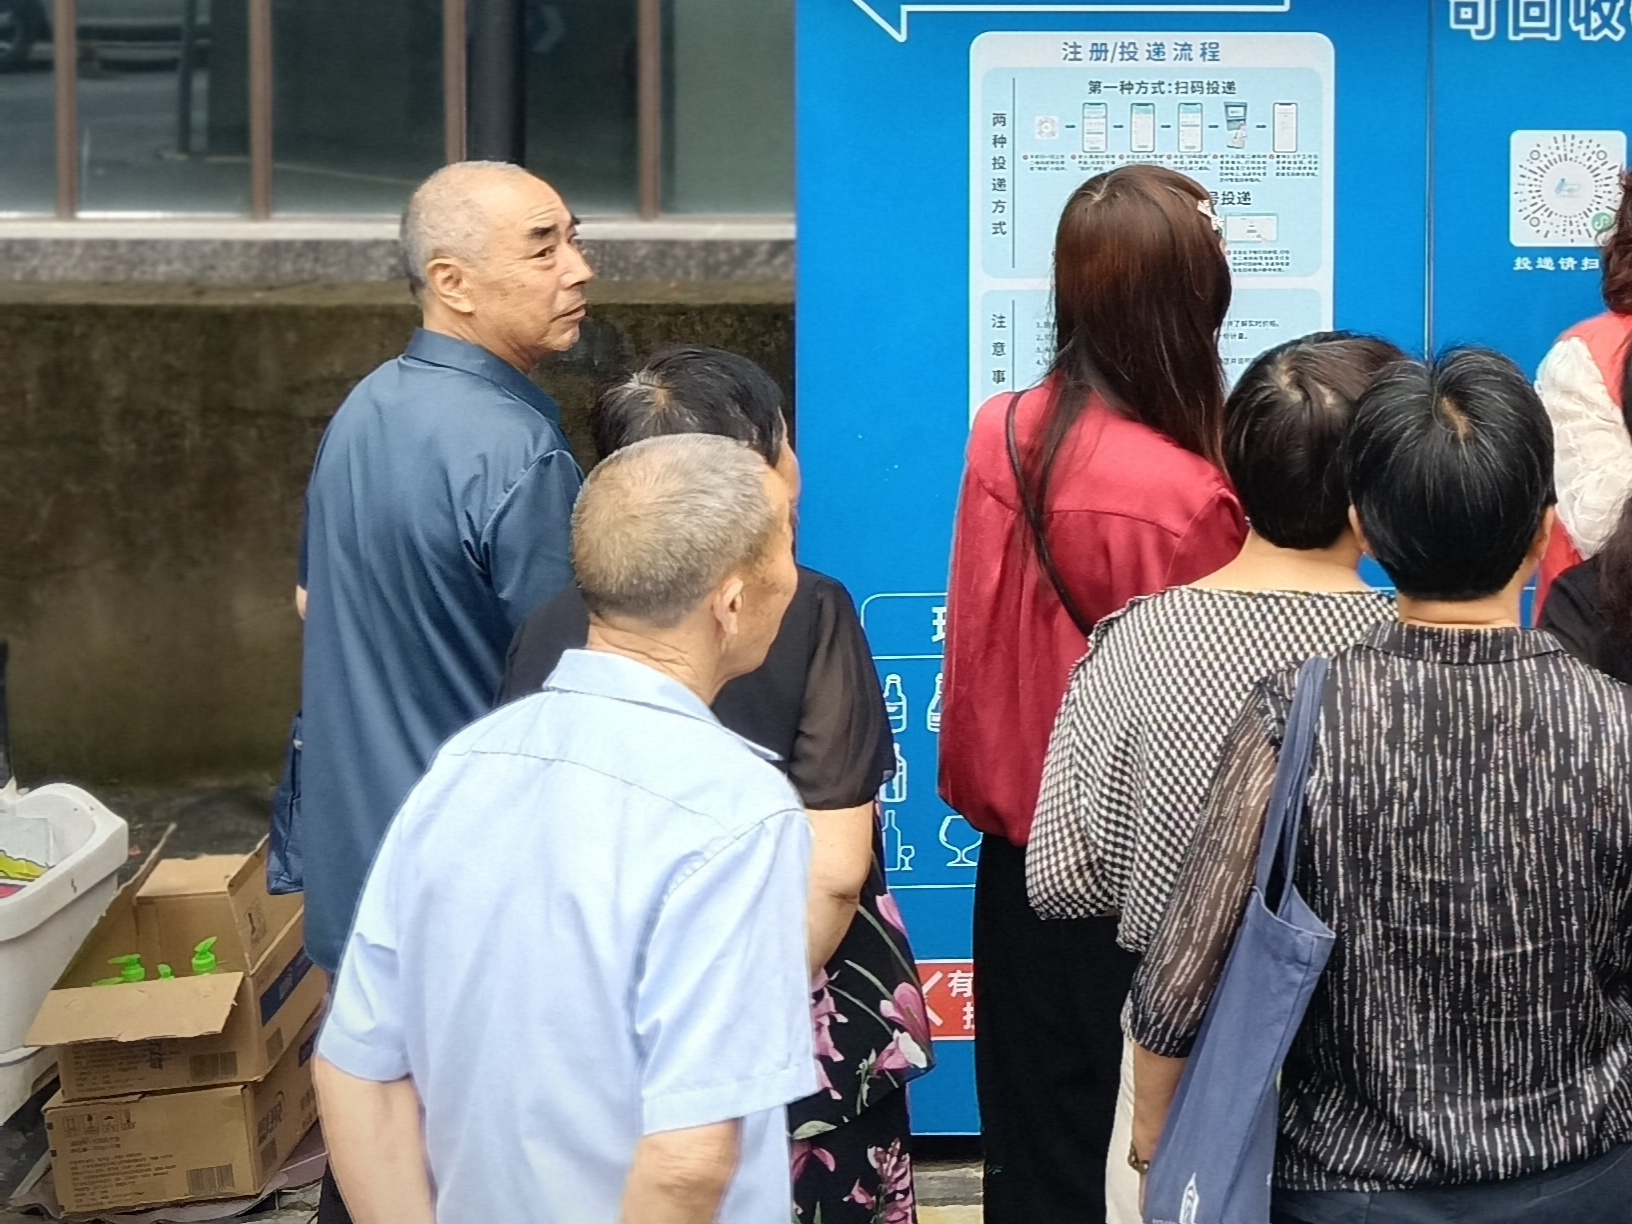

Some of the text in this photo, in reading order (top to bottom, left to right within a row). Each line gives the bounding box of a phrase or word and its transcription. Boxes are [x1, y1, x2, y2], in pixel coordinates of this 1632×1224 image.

[1061, 41, 1221, 63] 注册/投递流程
[991, 112, 1007, 236] 两种投递方式
